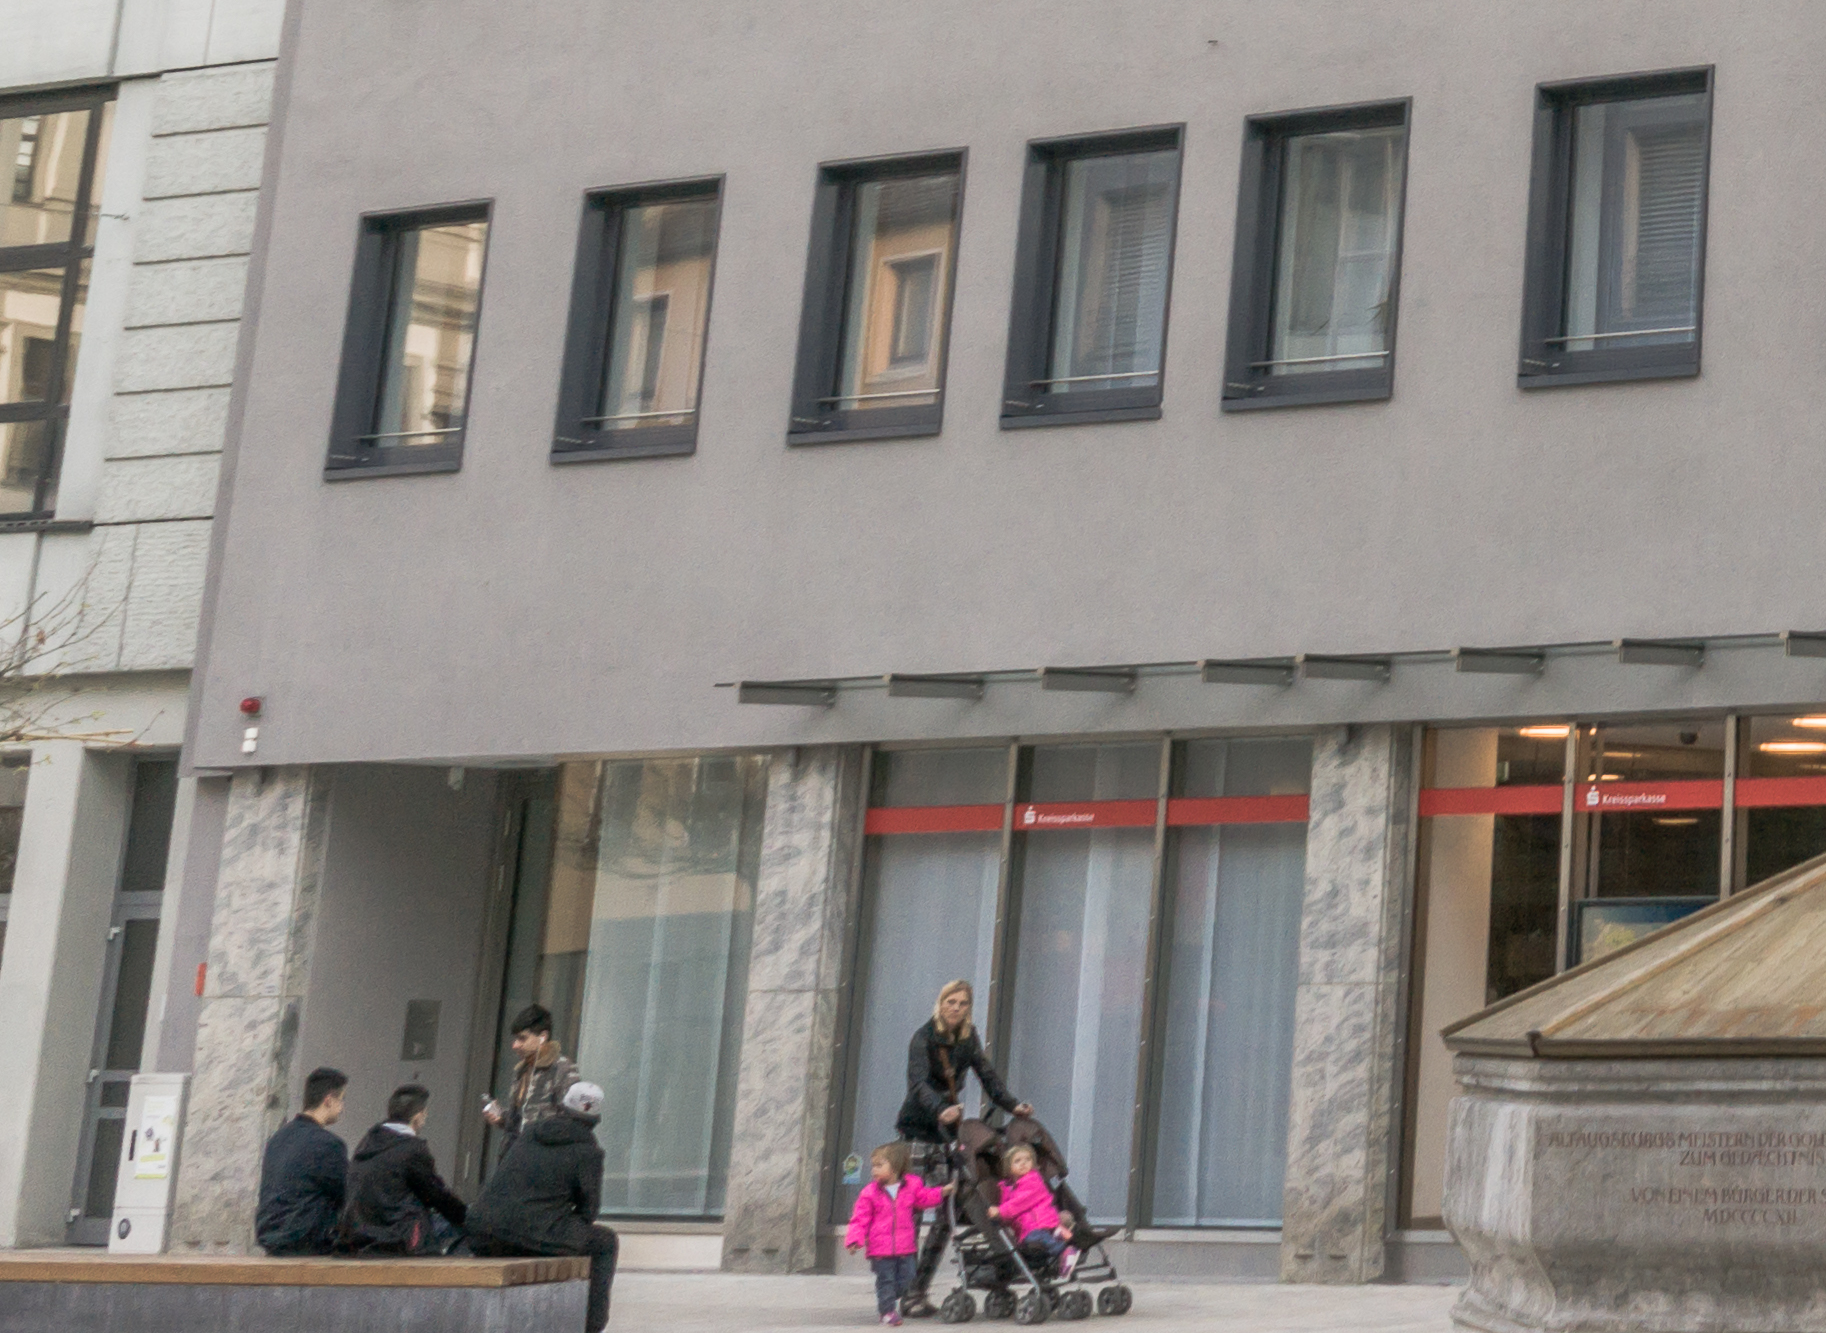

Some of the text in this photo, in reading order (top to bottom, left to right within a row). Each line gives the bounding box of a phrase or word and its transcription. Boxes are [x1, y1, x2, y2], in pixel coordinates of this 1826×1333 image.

[1601, 791, 1667, 806] Kreissparkasse
[1758, 1132, 1787, 1148] DER
[1679, 1149, 1717, 1166] ZUM
[1786, 1187, 1818, 1205] DER
